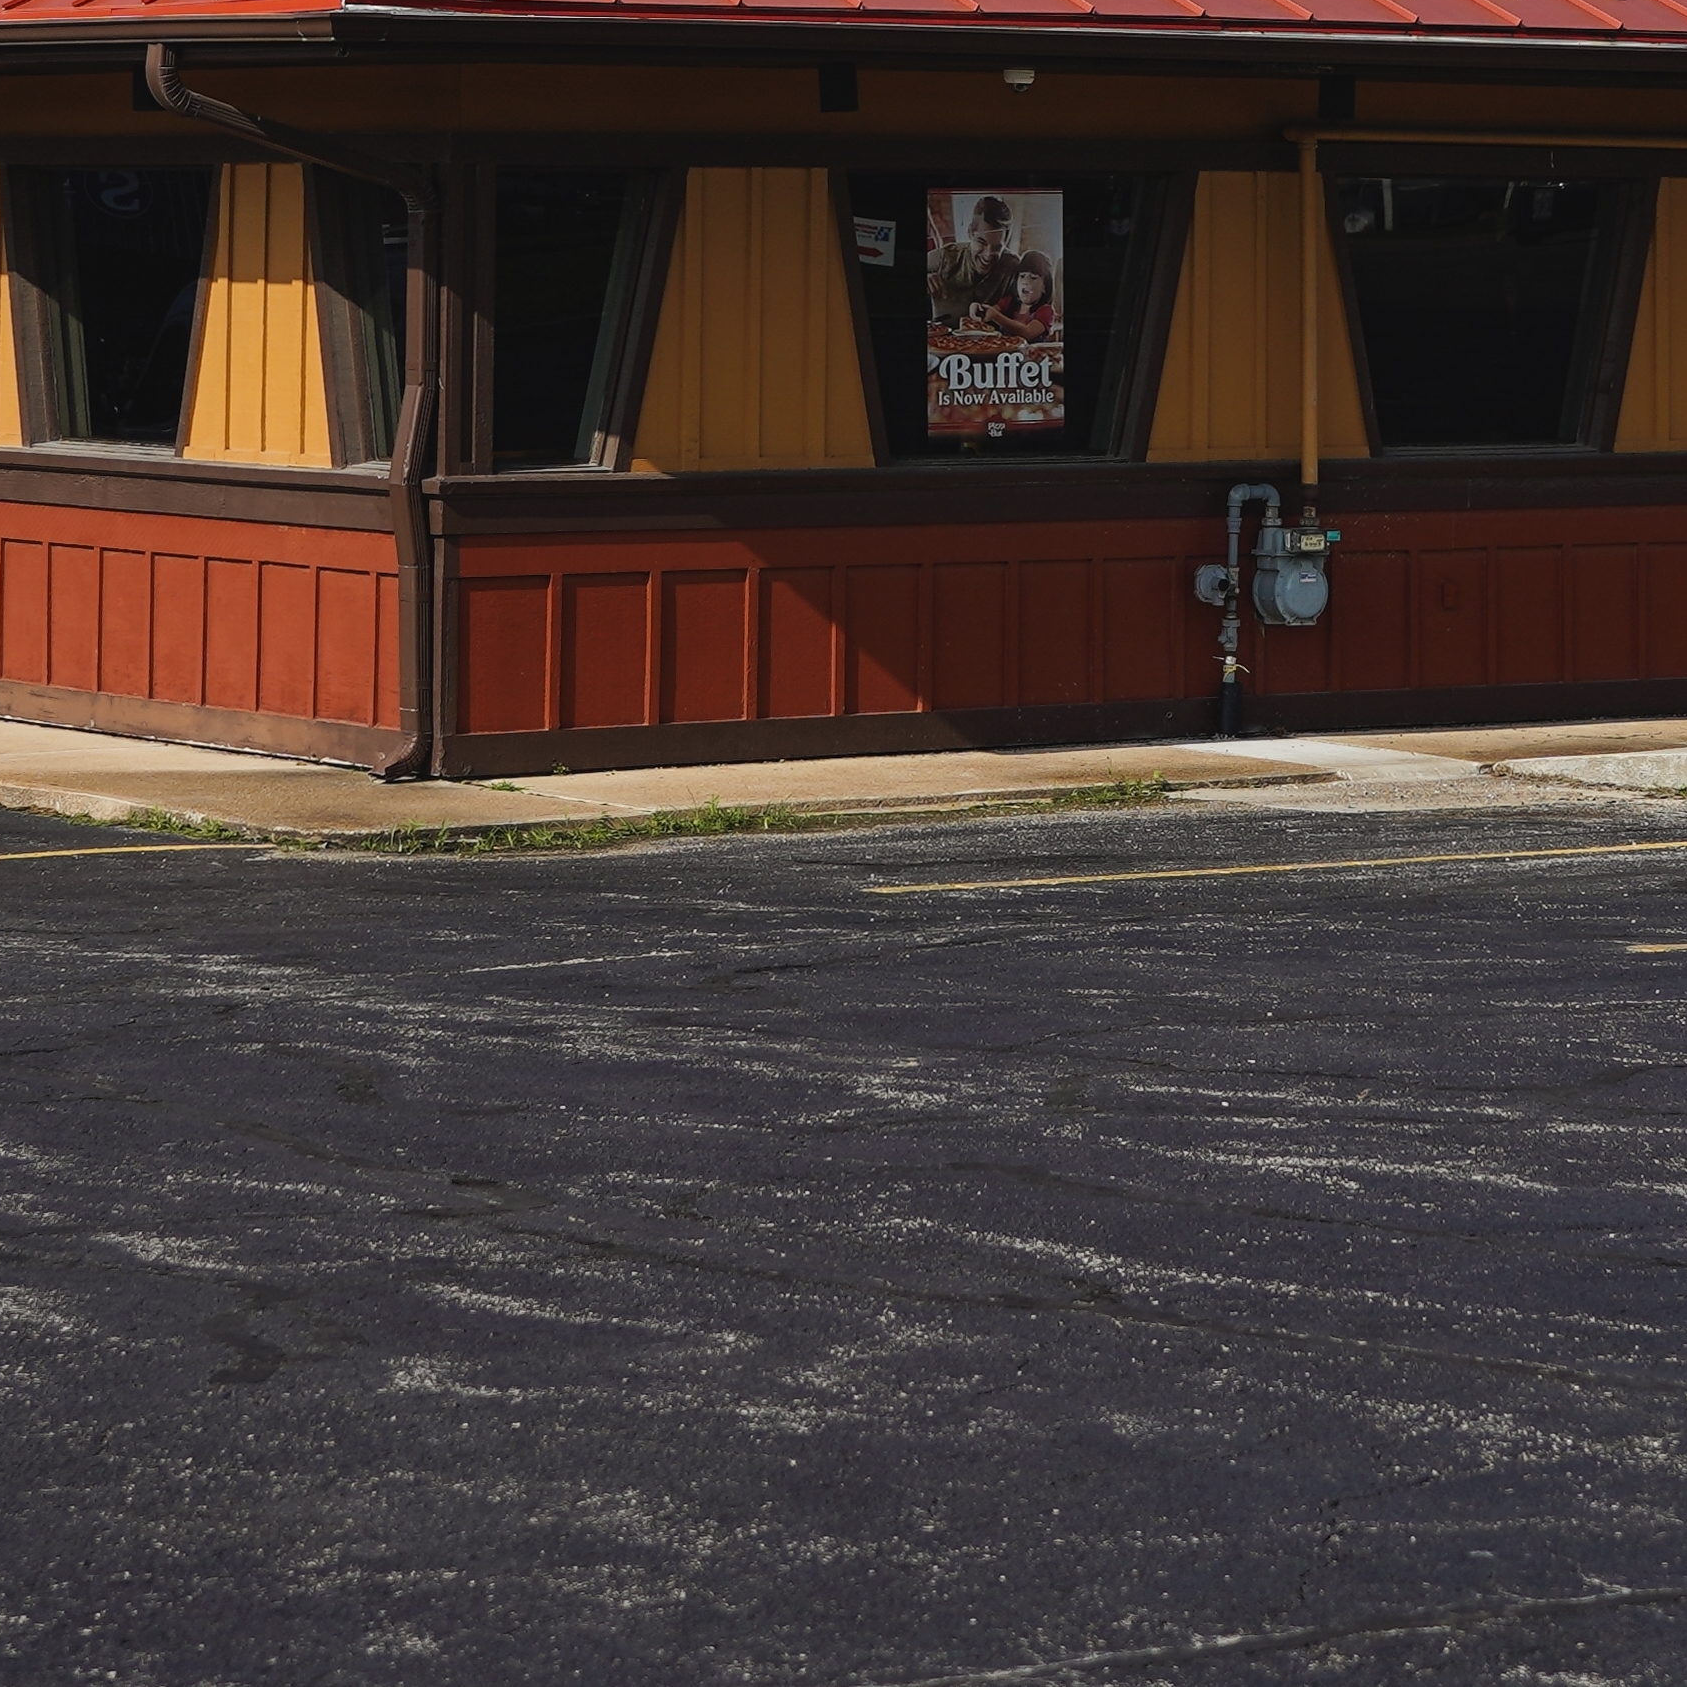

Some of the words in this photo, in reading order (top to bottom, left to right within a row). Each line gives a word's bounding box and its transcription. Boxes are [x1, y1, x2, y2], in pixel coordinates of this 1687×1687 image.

[938, 352, 1053, 390] Buffet
[938, 391, 951, 406] Is
[953, 391, 986, 406] Now
[989, 389, 1055, 405] Available
